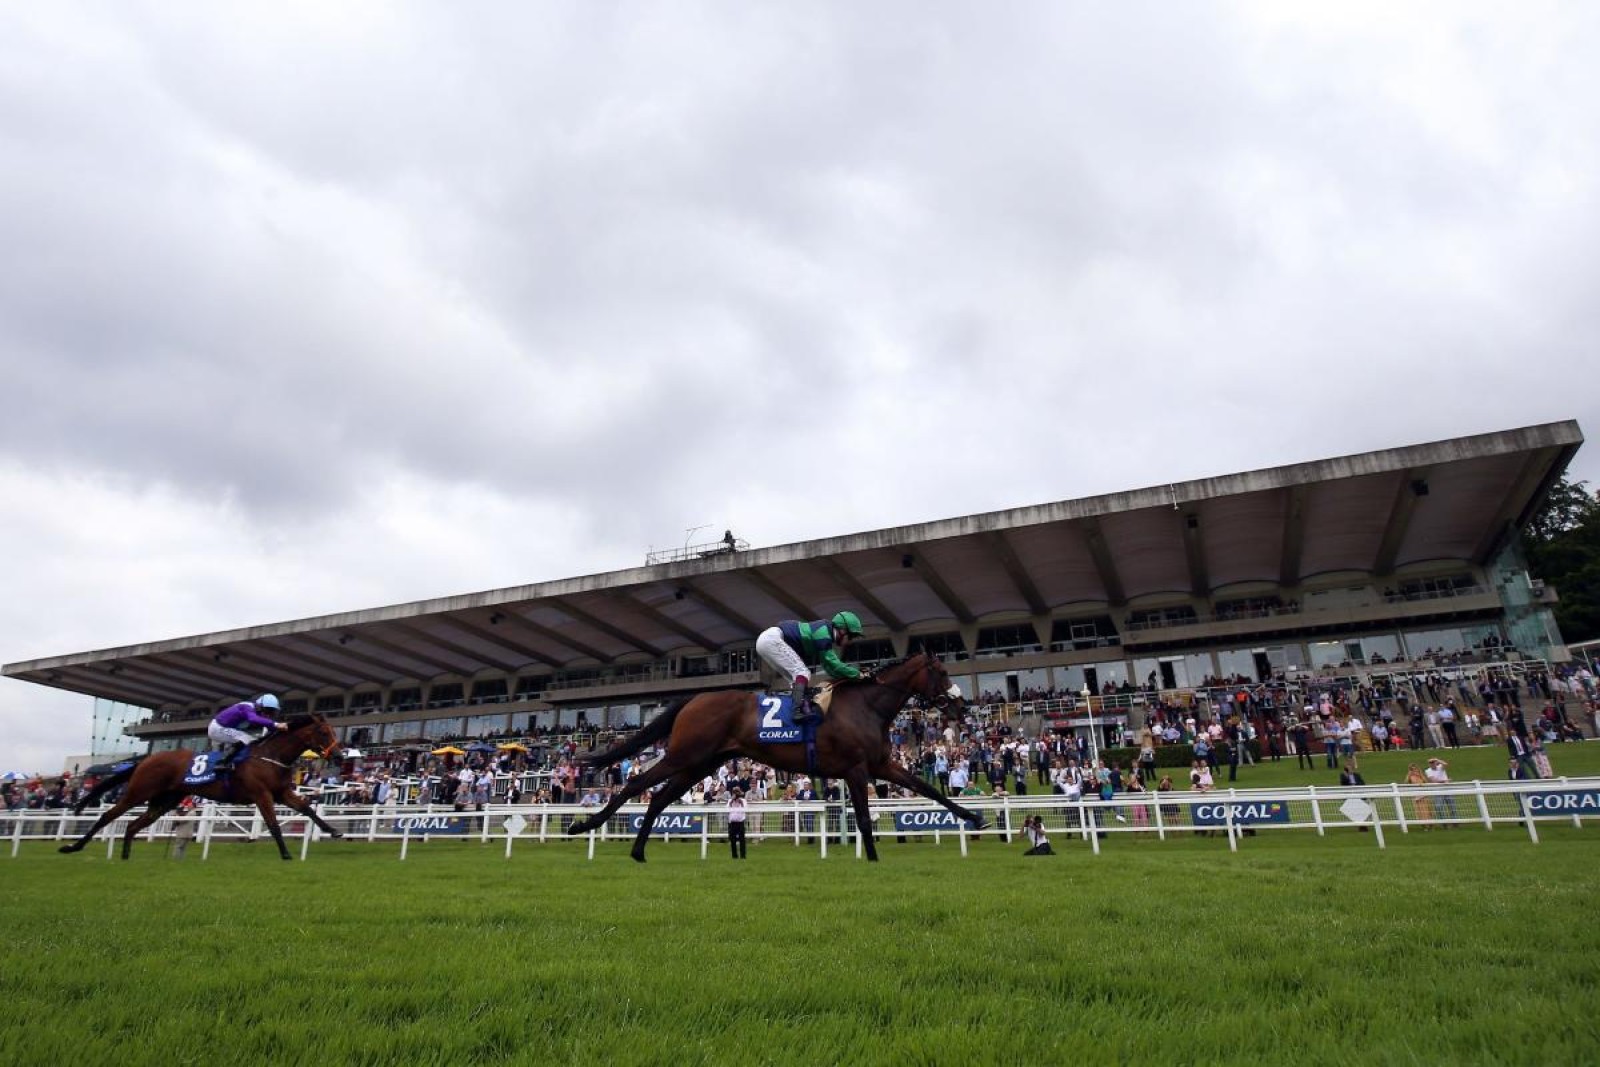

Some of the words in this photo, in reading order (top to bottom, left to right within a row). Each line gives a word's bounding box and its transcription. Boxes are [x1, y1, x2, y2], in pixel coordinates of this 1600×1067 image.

[761, 697, 783, 728] 2
[759, 730, 795, 739] CORAL
[191, 754, 209, 776] 8
[1196, 803, 1272, 819] CORAL
[398, 817, 449, 829] CORAL
